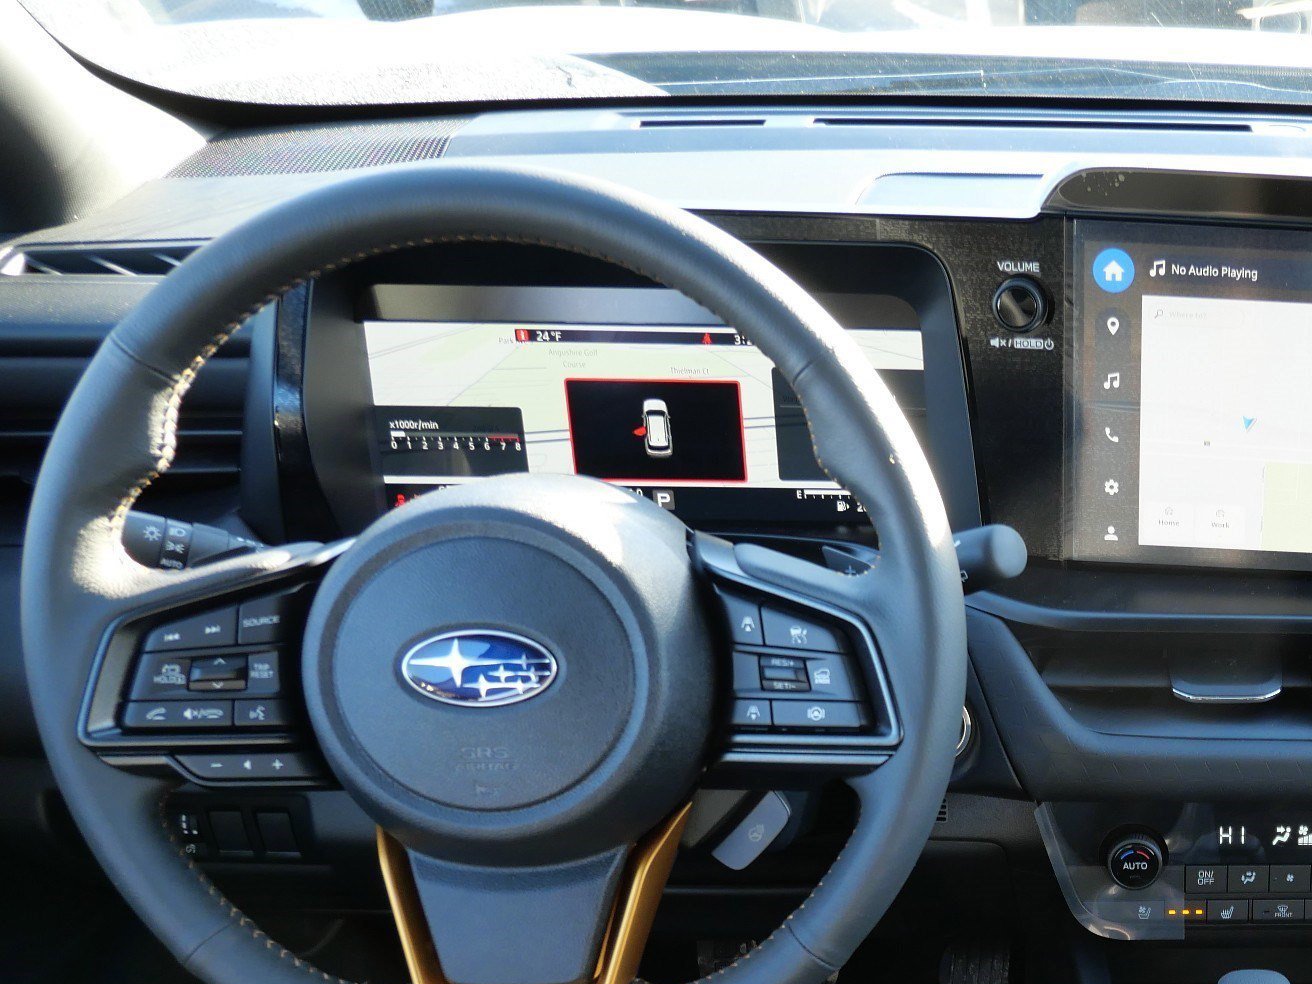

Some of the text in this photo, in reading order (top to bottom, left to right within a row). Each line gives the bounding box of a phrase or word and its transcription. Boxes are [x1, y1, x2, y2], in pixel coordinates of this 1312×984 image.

[997, 261, 1040, 273] VOLUME
[1171, 263, 1258, 281] No Audio Playing
[1014, 339, 1043, 349] HOLD
[389, 419, 439, 431] x1000r/min
[391, 441, 522, 451] 0 1 2 3 4 5 6 7 8
[160, 558, 183, 570] AUTO
[242, 615, 280, 627] SOURCE
[460, 746, 509, 759] SRS
[1219, 825, 1245, 845] HI
[1123, 861, 1148, 870] AUTO
[1198, 870, 1214, 879] ON/
[1197, 878, 1215, 886] OFF
